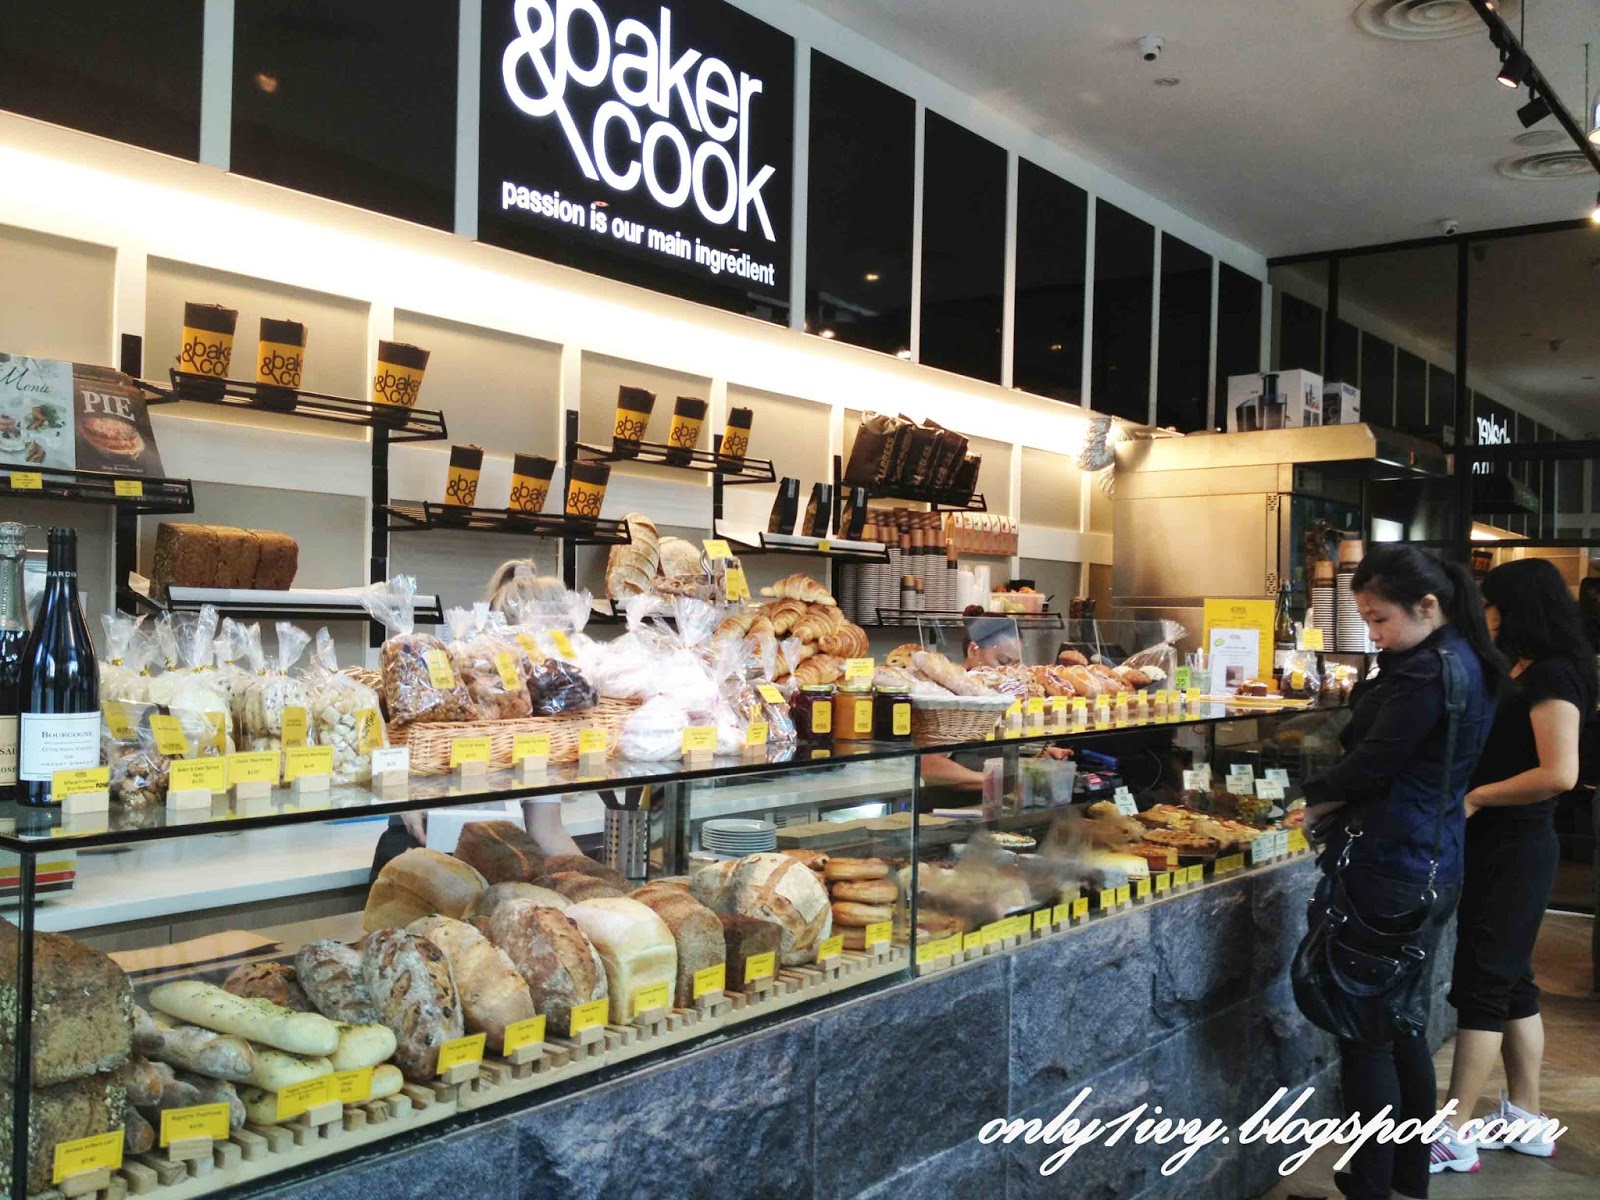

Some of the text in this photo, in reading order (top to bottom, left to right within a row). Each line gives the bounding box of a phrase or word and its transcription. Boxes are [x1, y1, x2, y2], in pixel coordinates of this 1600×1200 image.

[592, 100, 777, 243] cook
[502, 181, 775, 286] passion is our main ingredient
[0, 366, 53, 393] Menu
[81, 390, 136, 421] PIE
